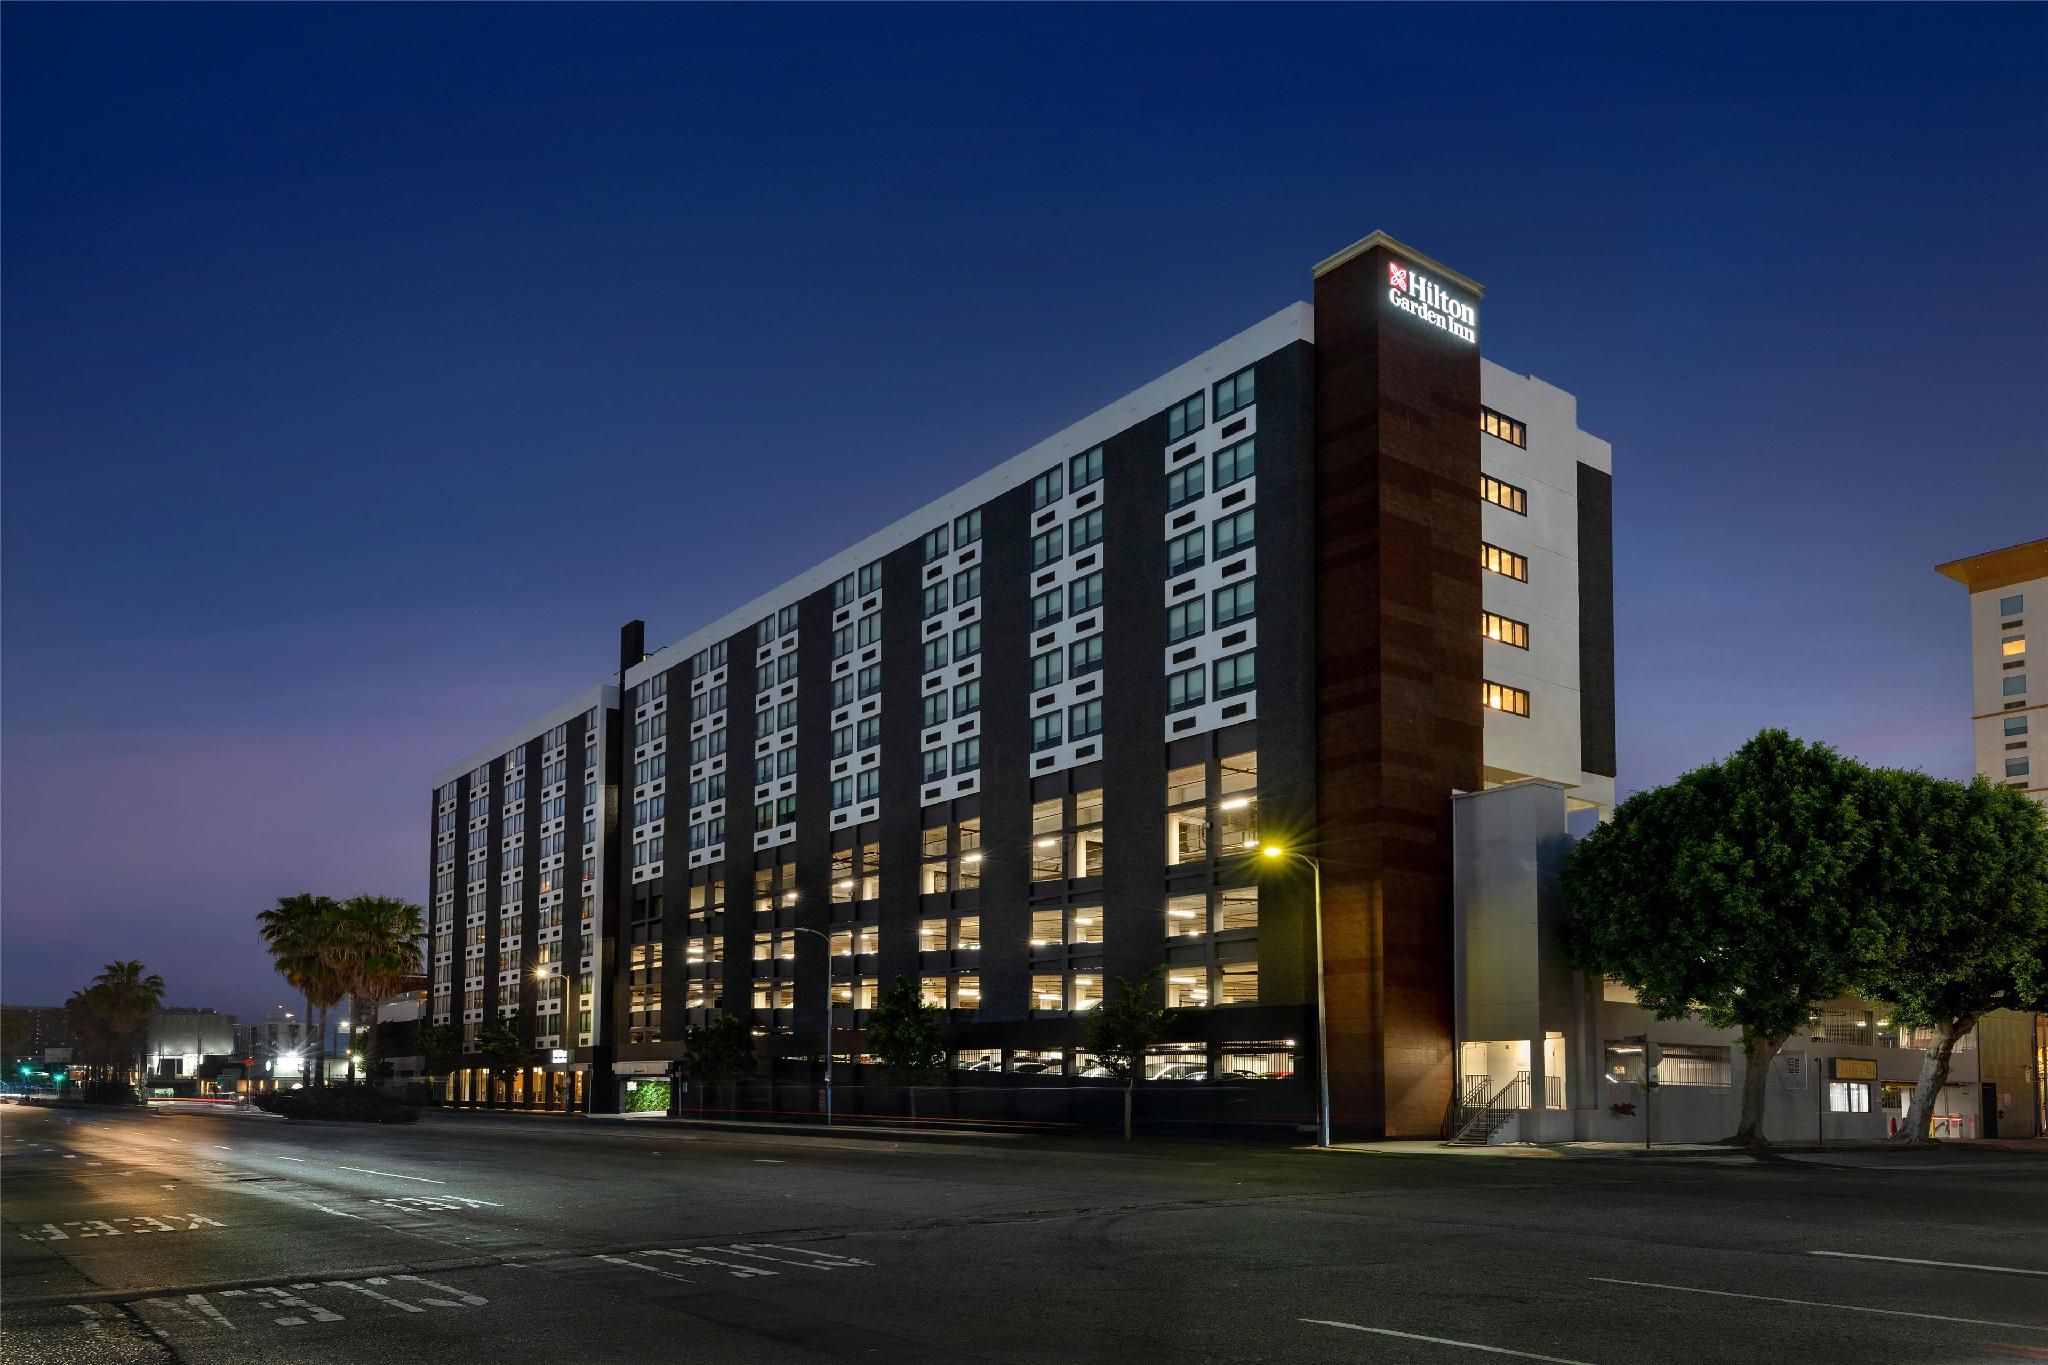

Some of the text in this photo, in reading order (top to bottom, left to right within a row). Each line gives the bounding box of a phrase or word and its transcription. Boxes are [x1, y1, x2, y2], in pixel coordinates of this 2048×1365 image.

[1389, 288, 1475, 343] Garden Inn
[1408, 271, 1475, 326] Hilton
